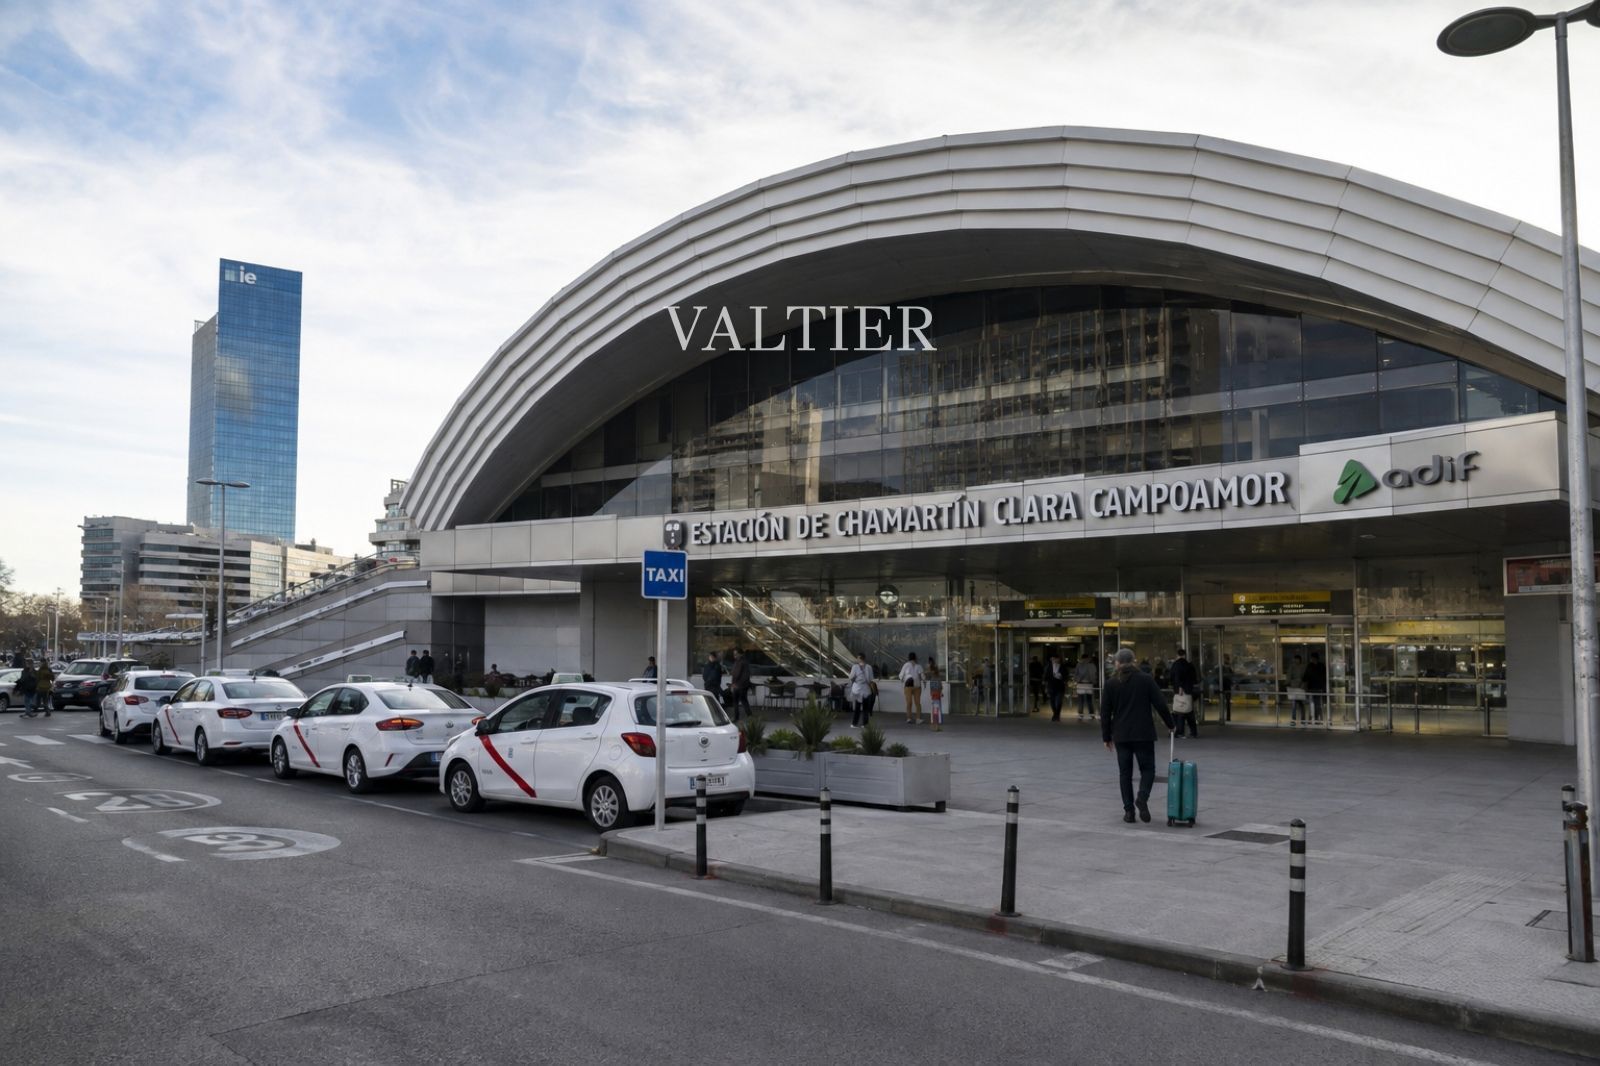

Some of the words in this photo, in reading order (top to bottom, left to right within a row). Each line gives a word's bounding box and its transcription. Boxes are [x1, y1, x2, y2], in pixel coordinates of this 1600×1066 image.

[240, 265, 257, 285] ie
[1382, 450, 1481, 489] adif
[690, 513, 787, 545] ESTACIÓN
[796, 514, 827, 540] DE
[834, 494, 982, 537] CHAMARTÍN
[993, 491, 1079, 525] CLARA
[1089, 471, 1287, 518] CAMPOAMOR
[646, 567, 685, 583] TAXI
